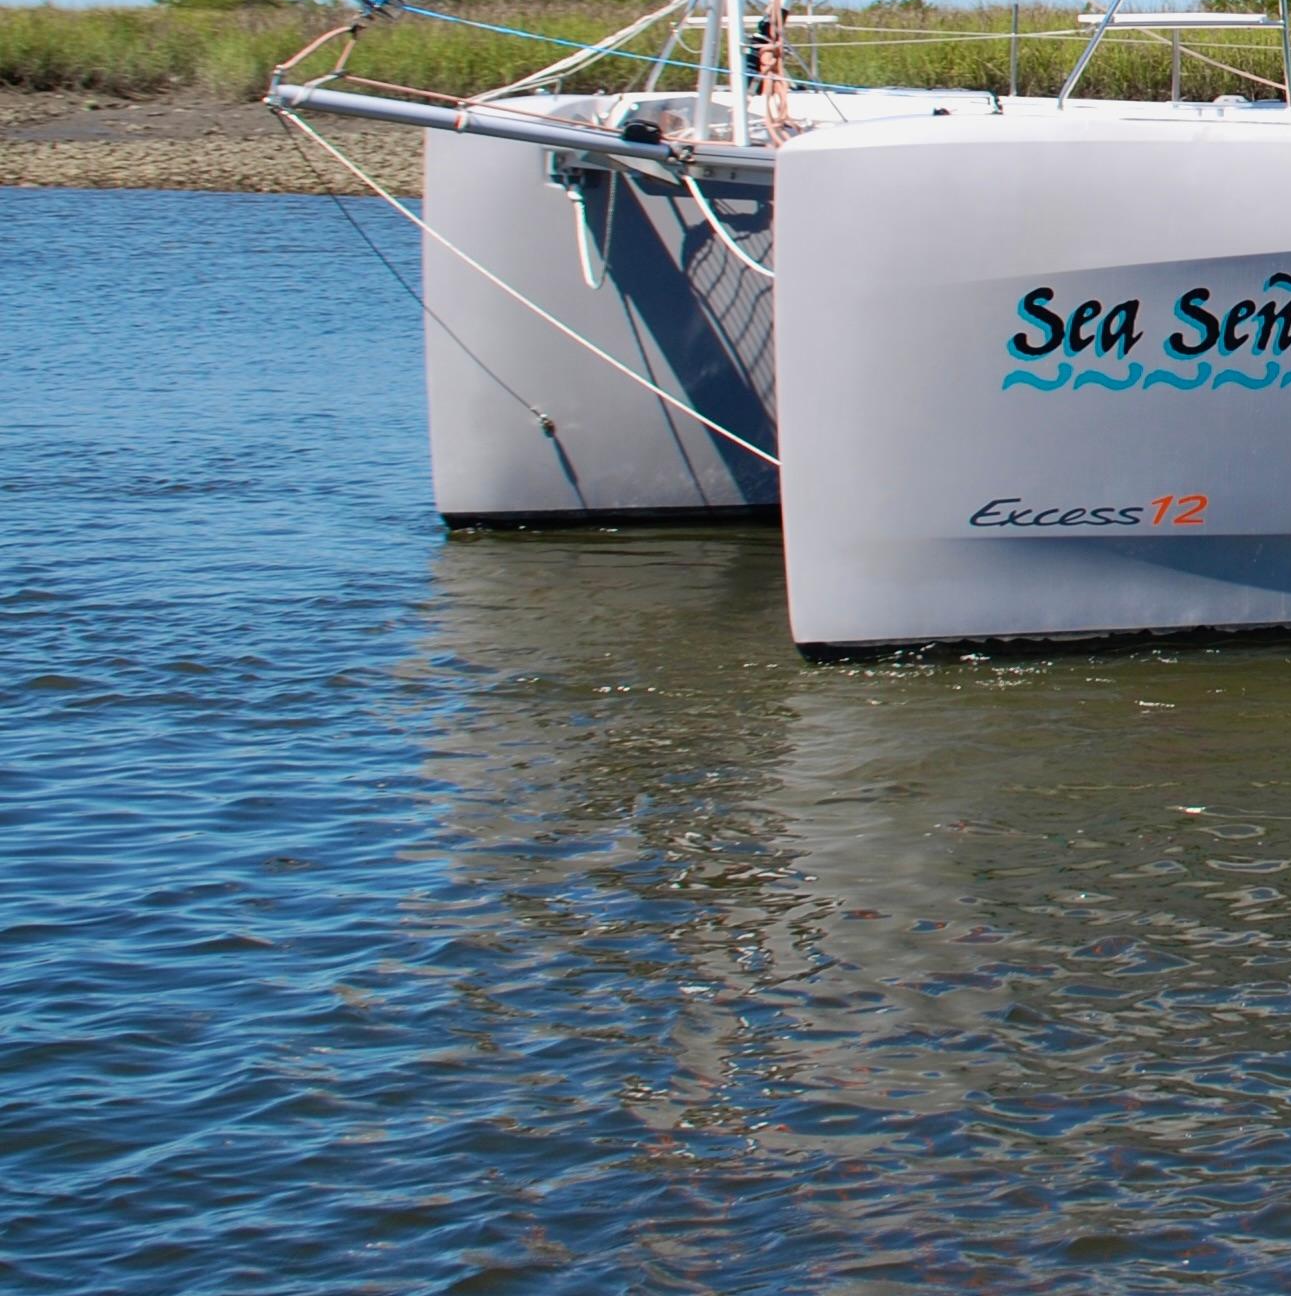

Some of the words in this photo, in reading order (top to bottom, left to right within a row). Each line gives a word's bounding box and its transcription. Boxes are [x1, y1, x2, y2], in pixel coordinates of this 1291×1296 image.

[1006, 286, 1144, 361] Sea
[968, 497, 1145, 528] Excess
[1150, 494, 1209, 527] 12
